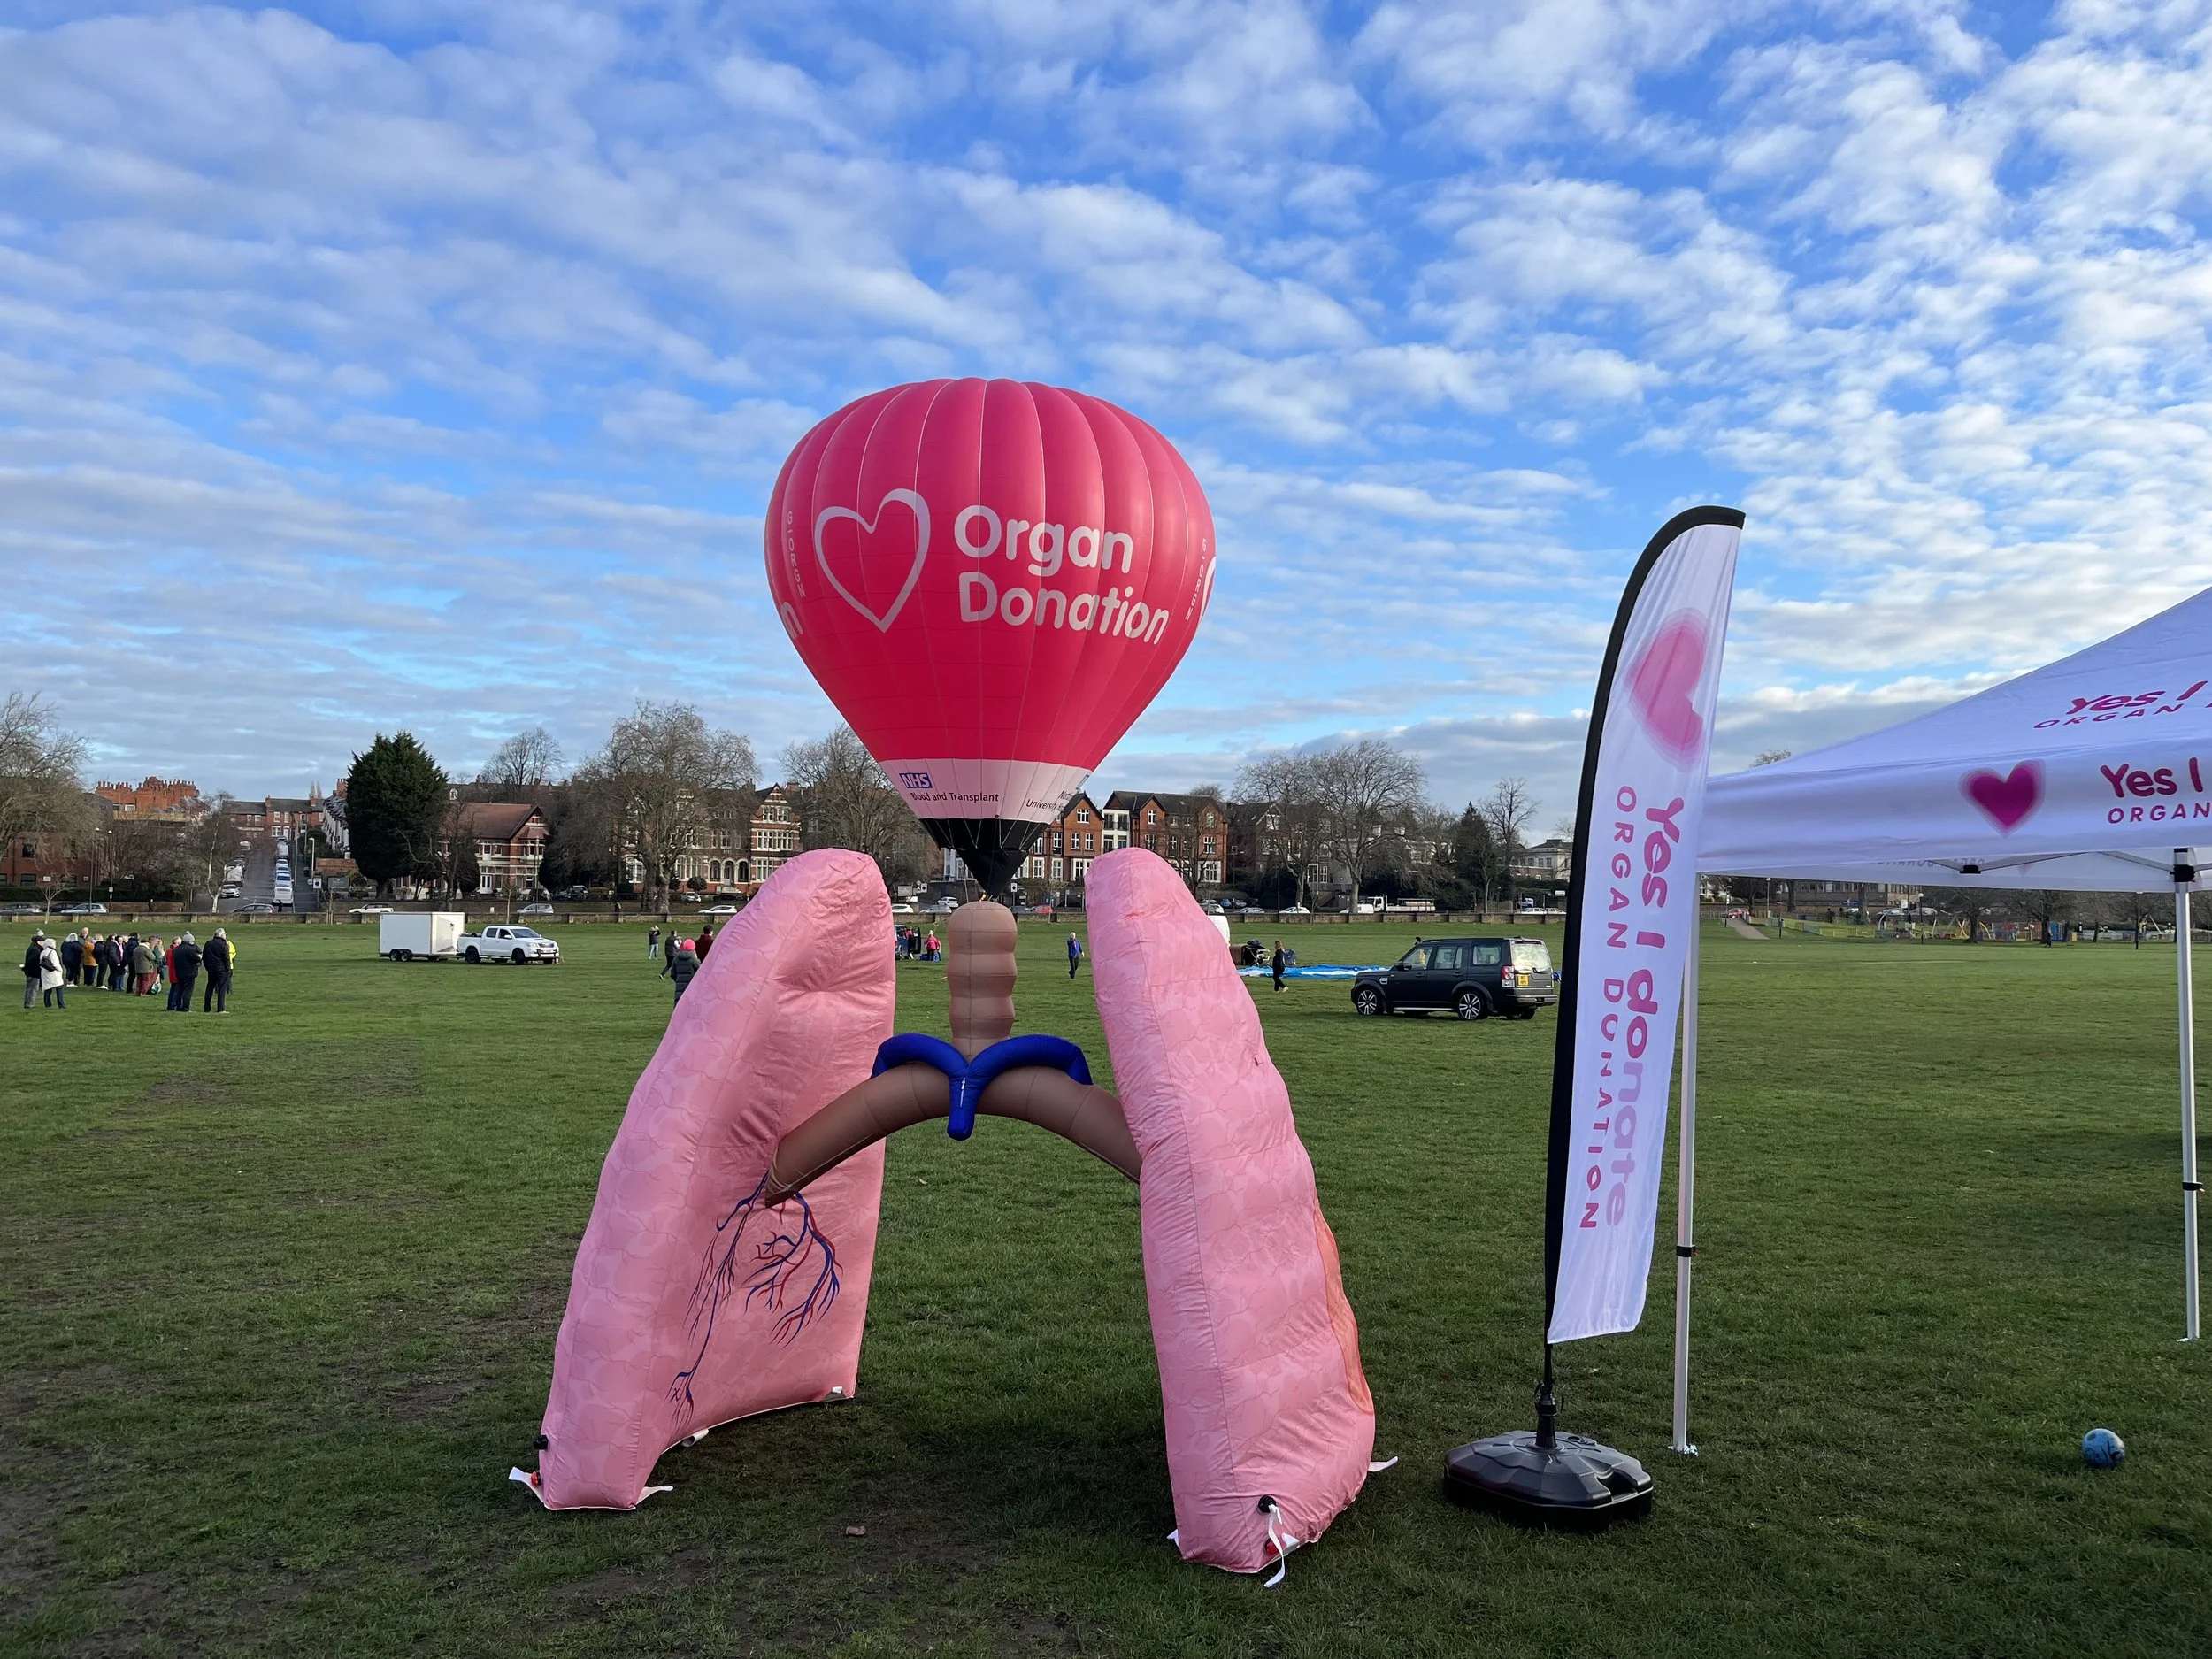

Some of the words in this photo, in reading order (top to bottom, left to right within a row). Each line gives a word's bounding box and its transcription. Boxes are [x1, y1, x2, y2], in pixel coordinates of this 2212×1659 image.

[954, 504, 1133, 577] Organ
[958, 572, 1170, 645] Donation
[2033, 703, 2184, 728] ORGAN
[2066, 690, 2166, 714] Yes
[900, 773, 932, 788] NHS
[910, 792, 931, 801] Blood
[932, 792, 947, 801] and
[949, 792, 999, 803] Transplant
[2100, 764, 2177, 798] Yes
[2189, 757, 2203, 793] I
[2108, 802, 2211, 824] ORGAN
[1606, 785, 1637, 949] ORGAN
[1641, 797, 1684, 908] Yes
[1579, 978, 1624, 1227] DONATION
[1606, 969, 1658, 1226] donate
